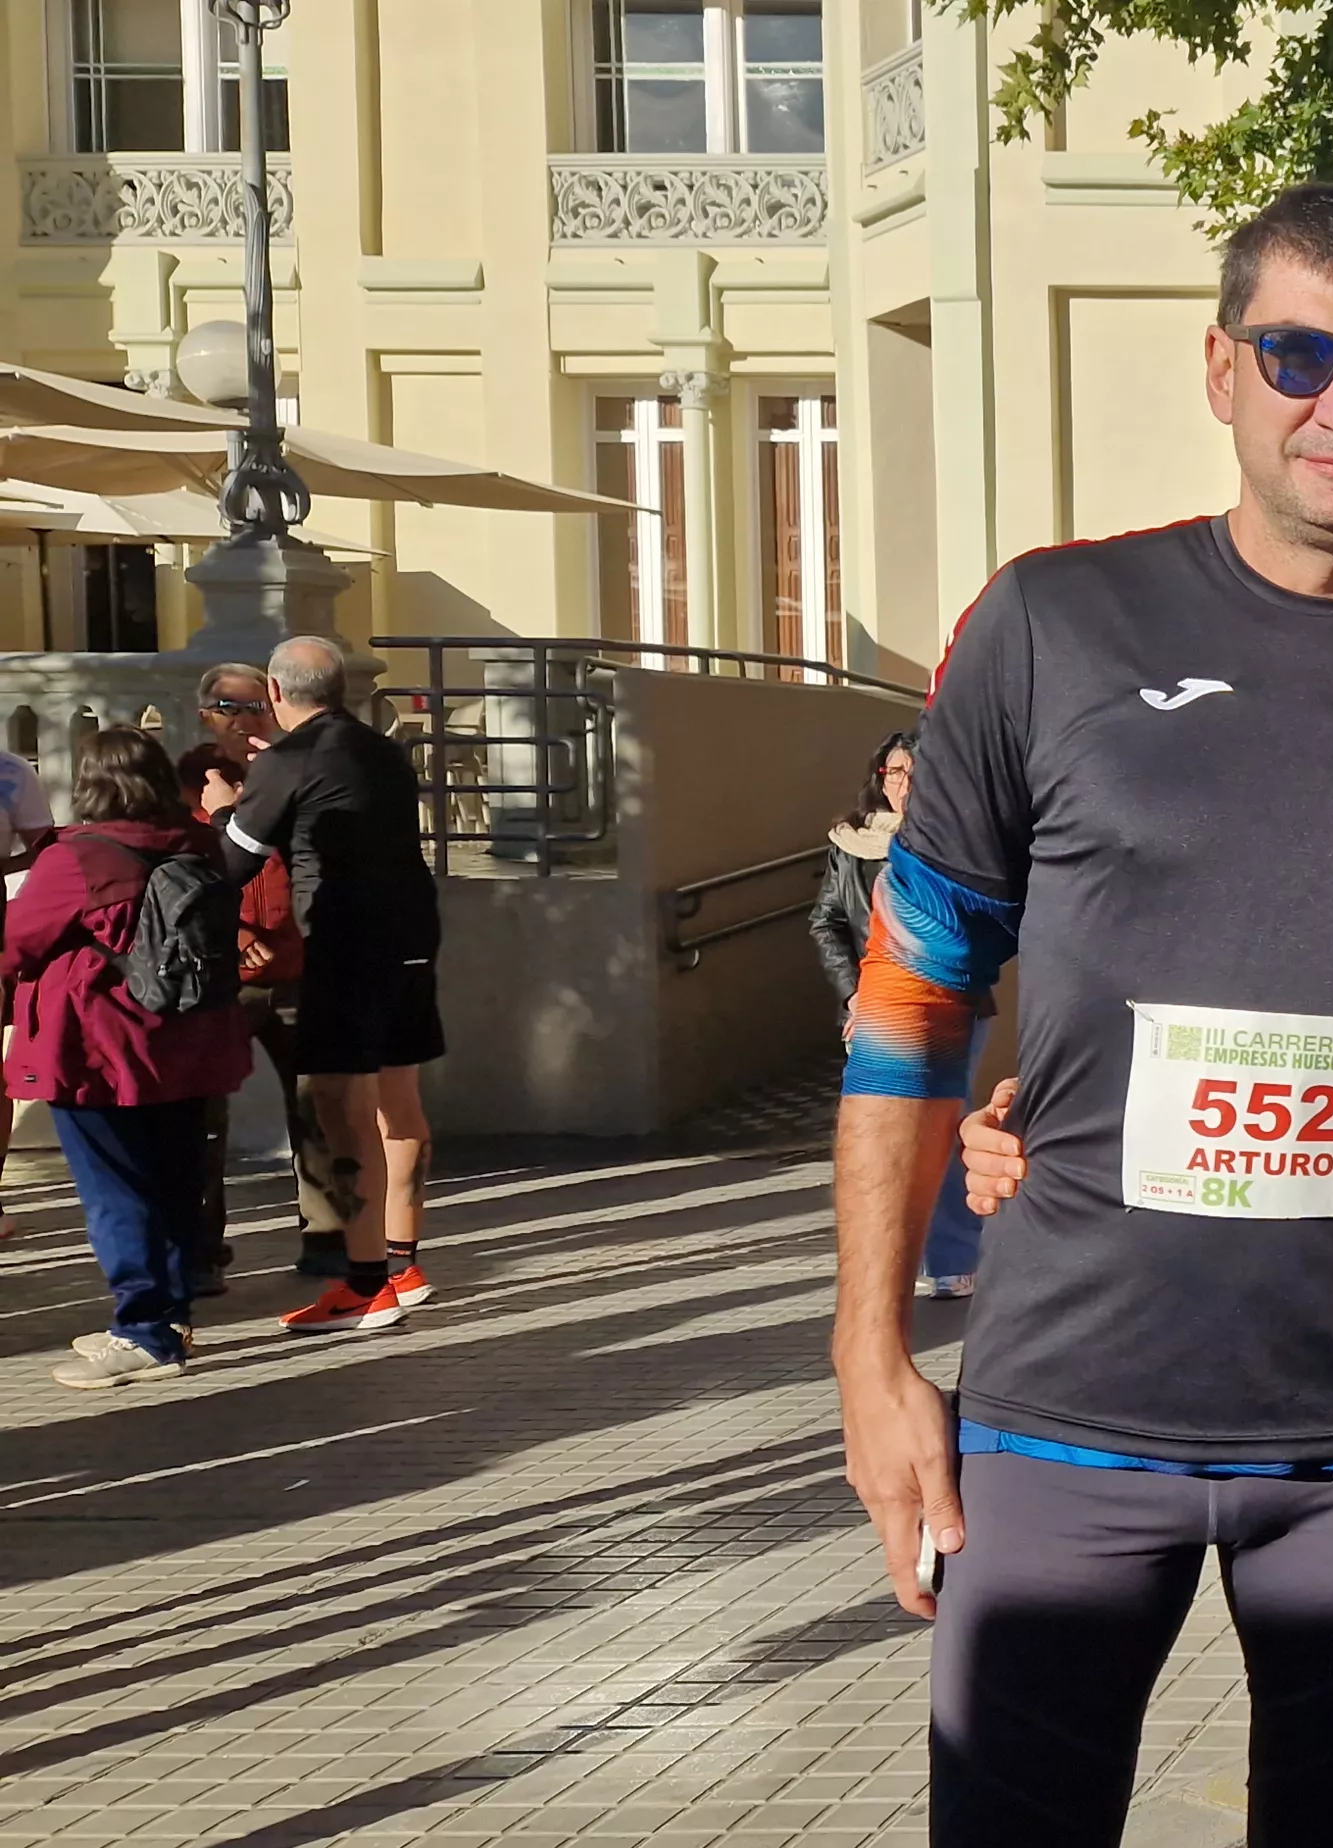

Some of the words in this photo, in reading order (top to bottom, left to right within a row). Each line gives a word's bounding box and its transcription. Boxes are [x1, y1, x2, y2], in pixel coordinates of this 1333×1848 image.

[1205, 1028, 1226, 1047] III
[1203, 1046, 1288, 1069] EMPRESAS
[1201, 1177, 1252, 1209] 8K
